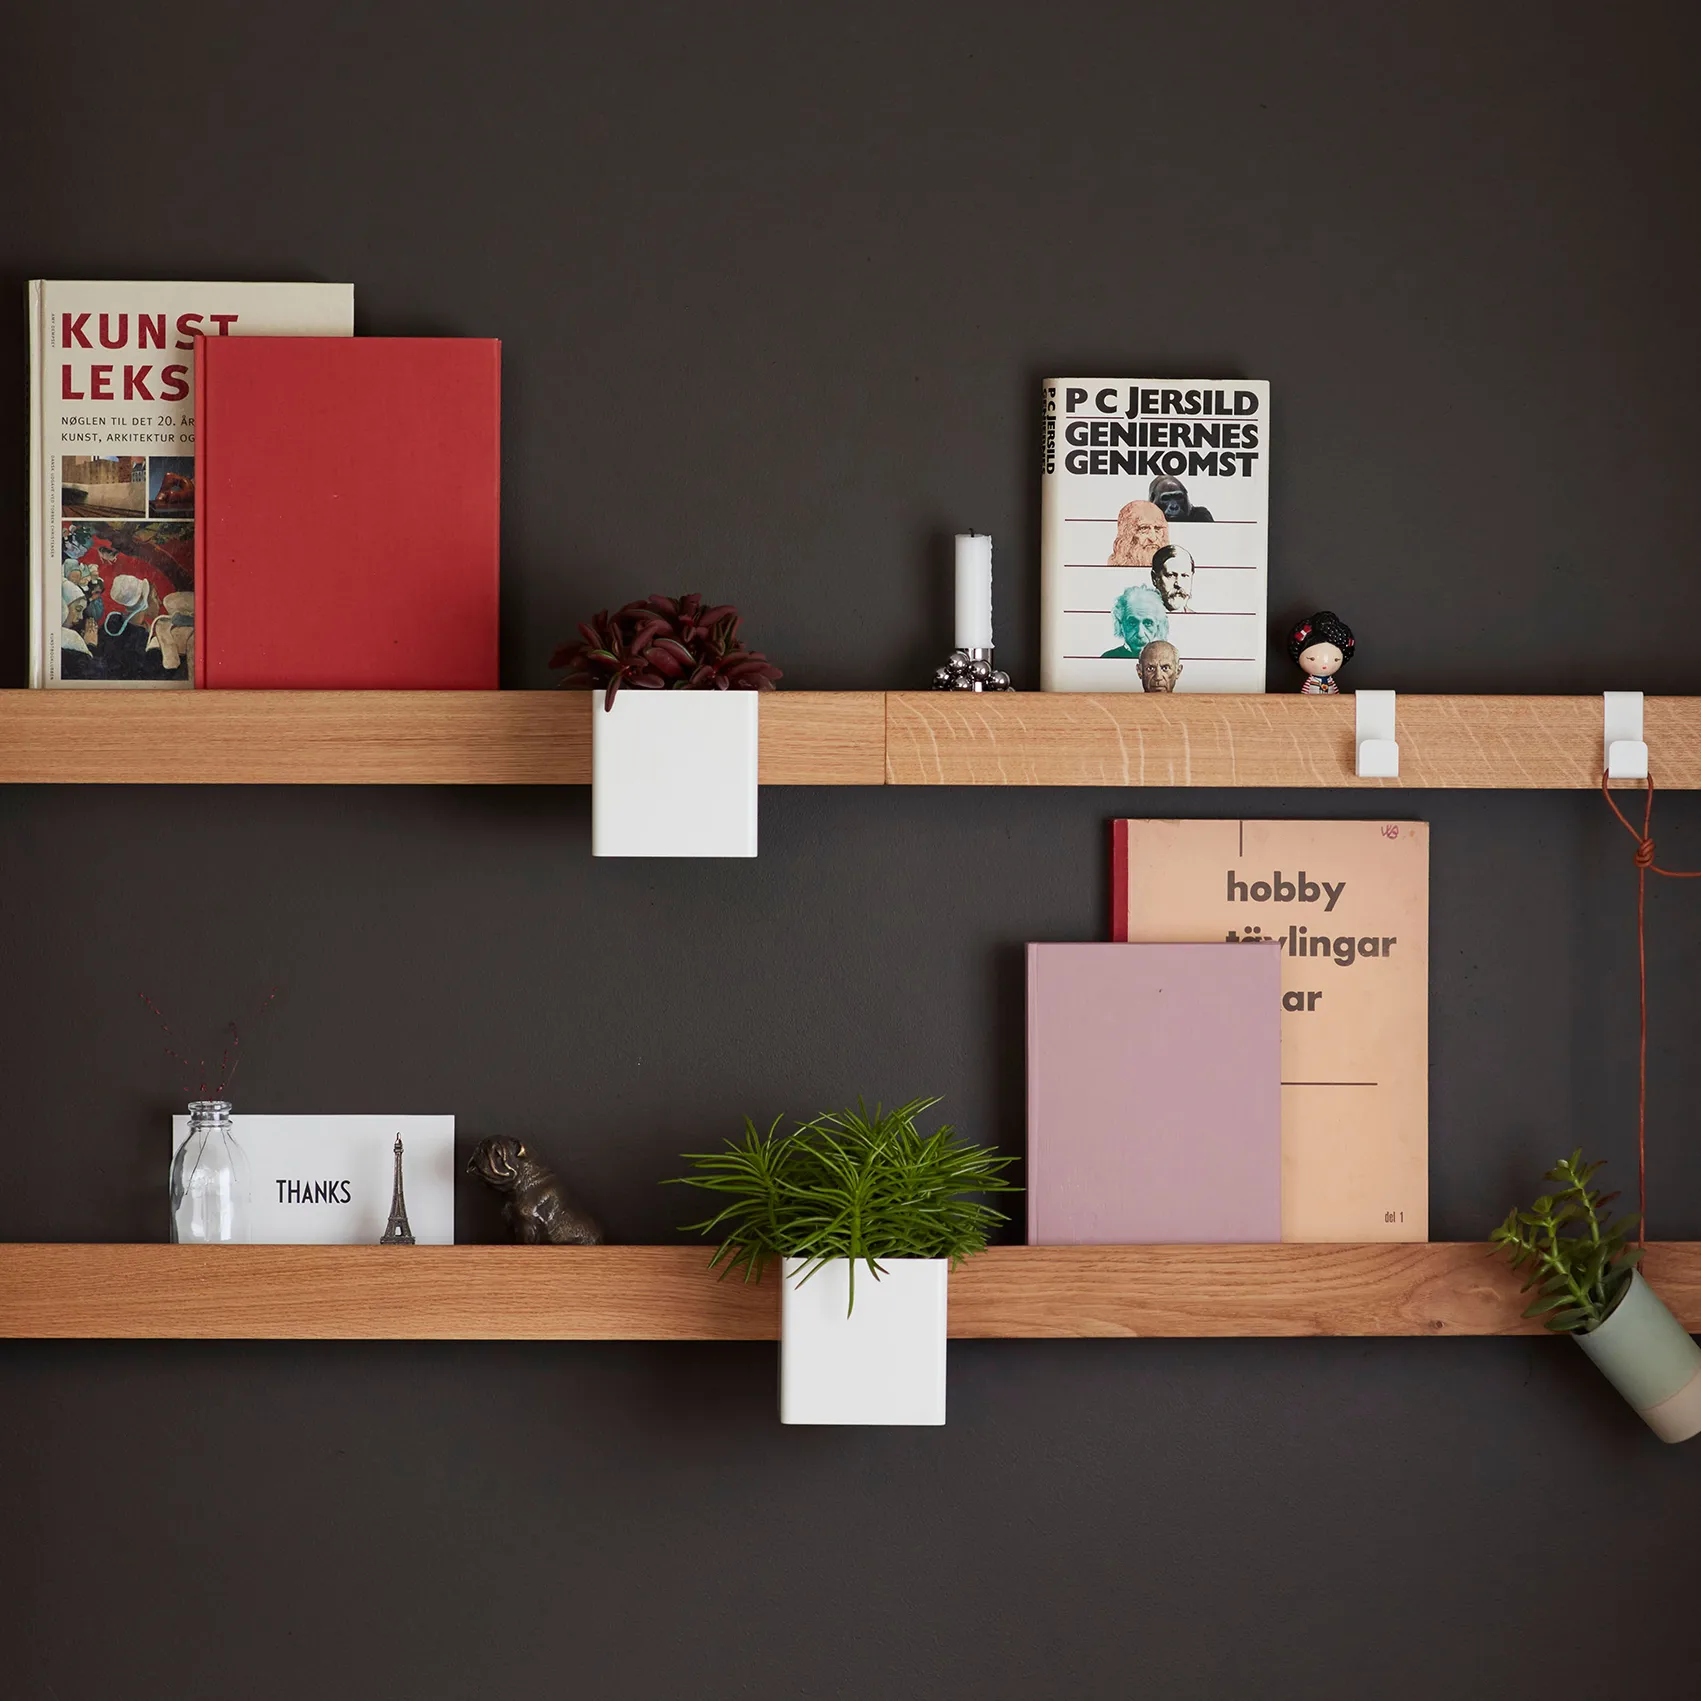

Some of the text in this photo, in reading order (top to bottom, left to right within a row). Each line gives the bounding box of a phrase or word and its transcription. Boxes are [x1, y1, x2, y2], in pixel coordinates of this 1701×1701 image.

[62, 313, 239, 351] KUNST
[62, 364, 190, 402] LEKS
[1066, 386, 1260, 420] P C JERSILD
[61, 415, 106, 427] NØGLEN
[111, 416, 128, 427] TIL
[132, 416, 154, 427] DET
[157, 415, 176, 427] 20.
[1047, 387, 1057, 475] P C JERSILD
[1065, 421, 1260, 449] GENIERNES
[61, 432, 195, 444] KUNST, ARKITEKTUR OG
[1065, 449, 1260, 477] GENKOMST
[1227, 870, 1347, 912] hobby
[1281, 990, 1323, 1012] ar
[275, 1179, 352, 1204] THANKS
[1384, 1211, 1404, 1223] del 1
